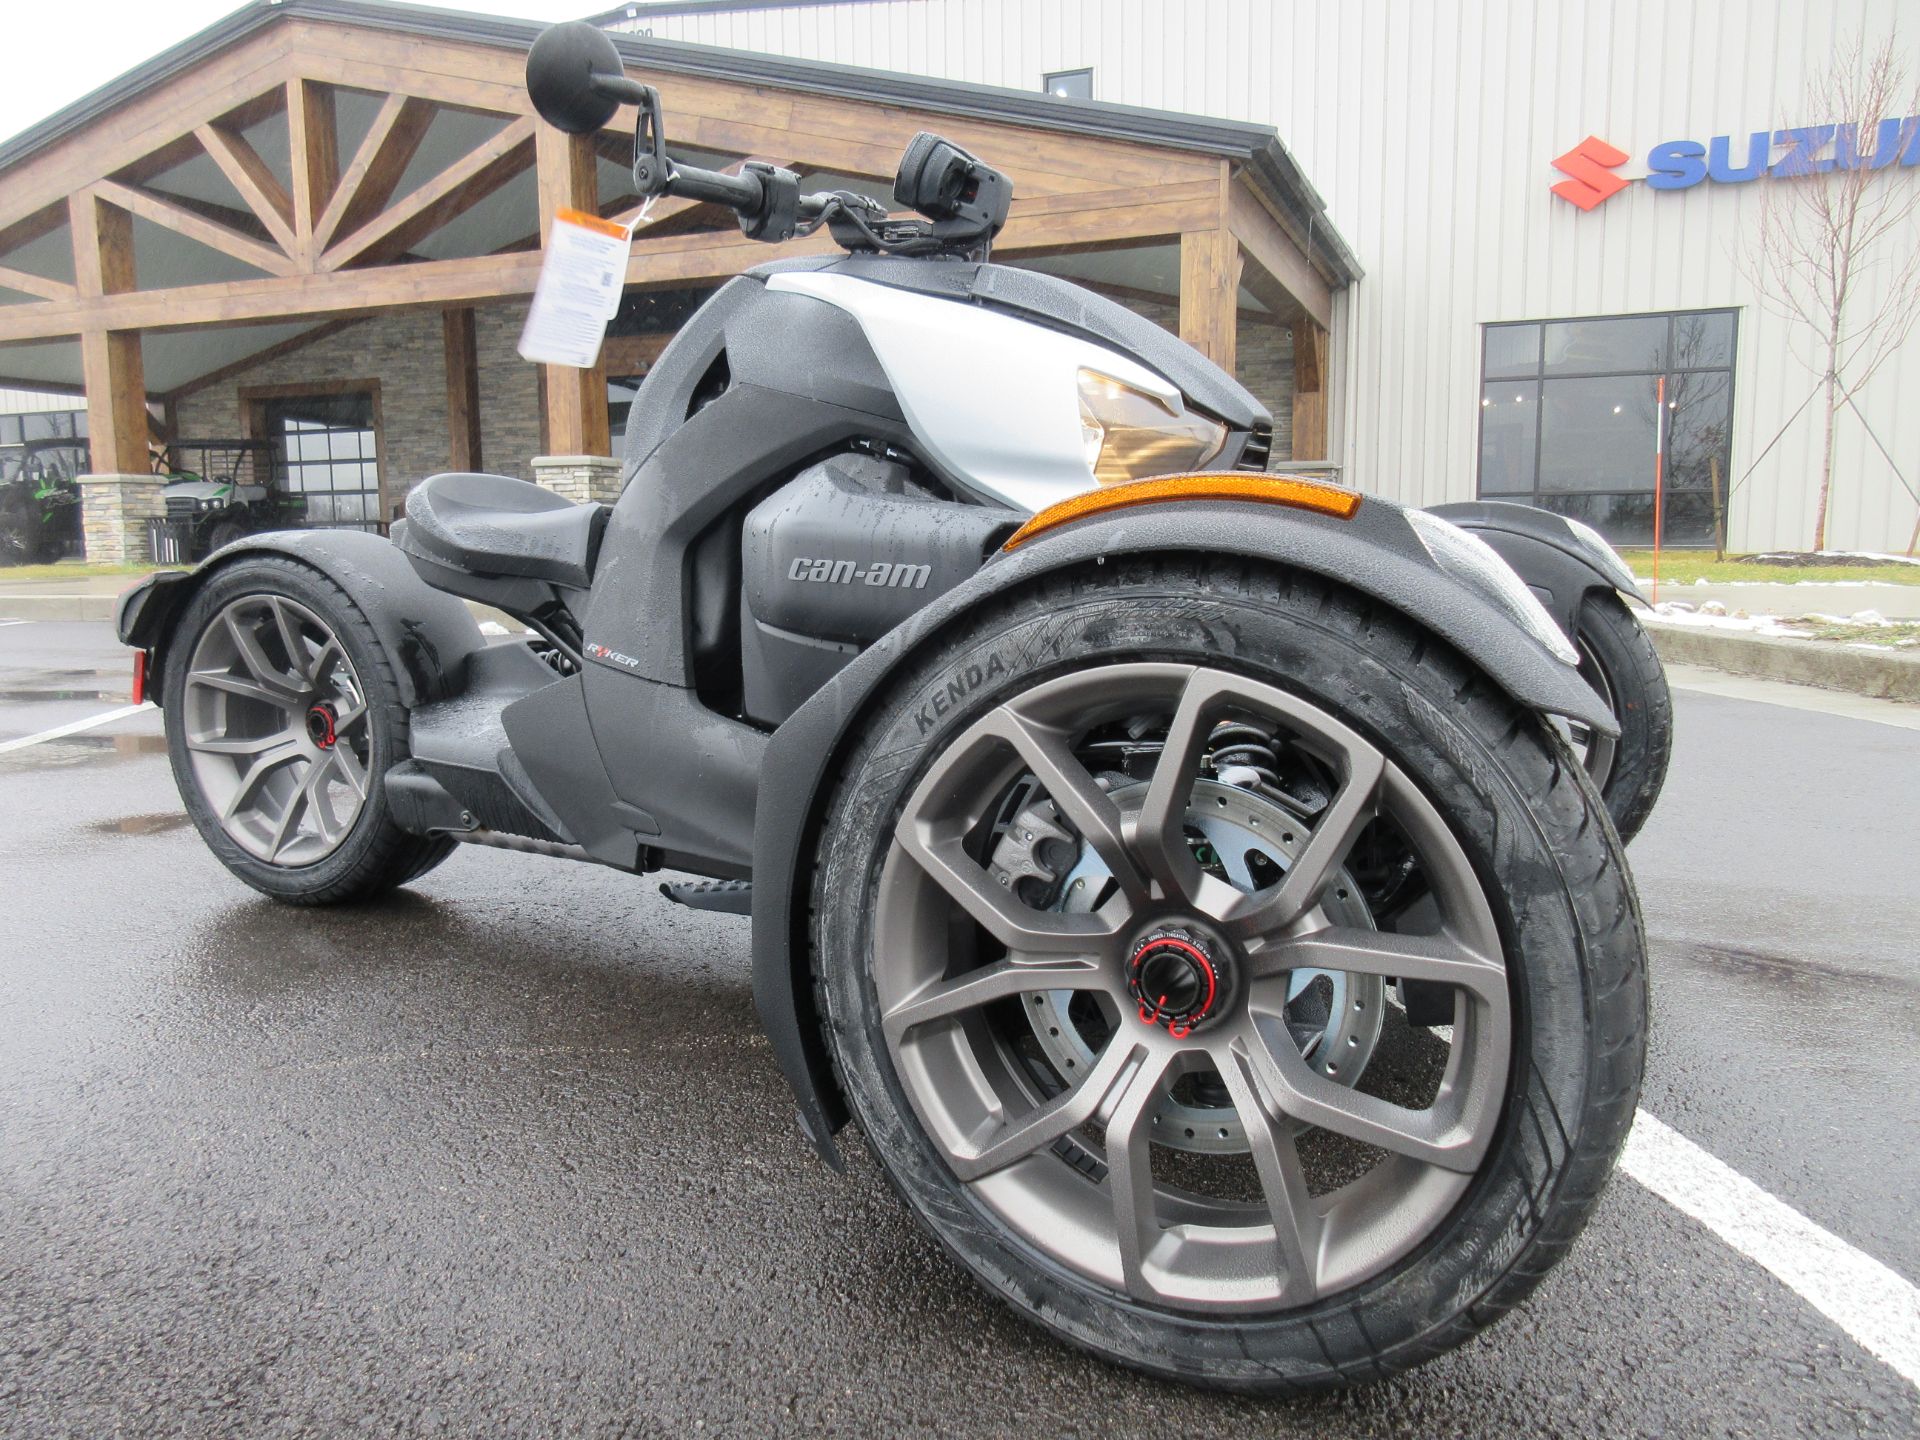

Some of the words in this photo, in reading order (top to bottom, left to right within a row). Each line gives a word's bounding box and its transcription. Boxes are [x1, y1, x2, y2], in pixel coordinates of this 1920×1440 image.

[788, 557, 932, 589] can-am
[587, 643, 639, 667] RYKER
[914, 652, 1005, 736] KENDA
